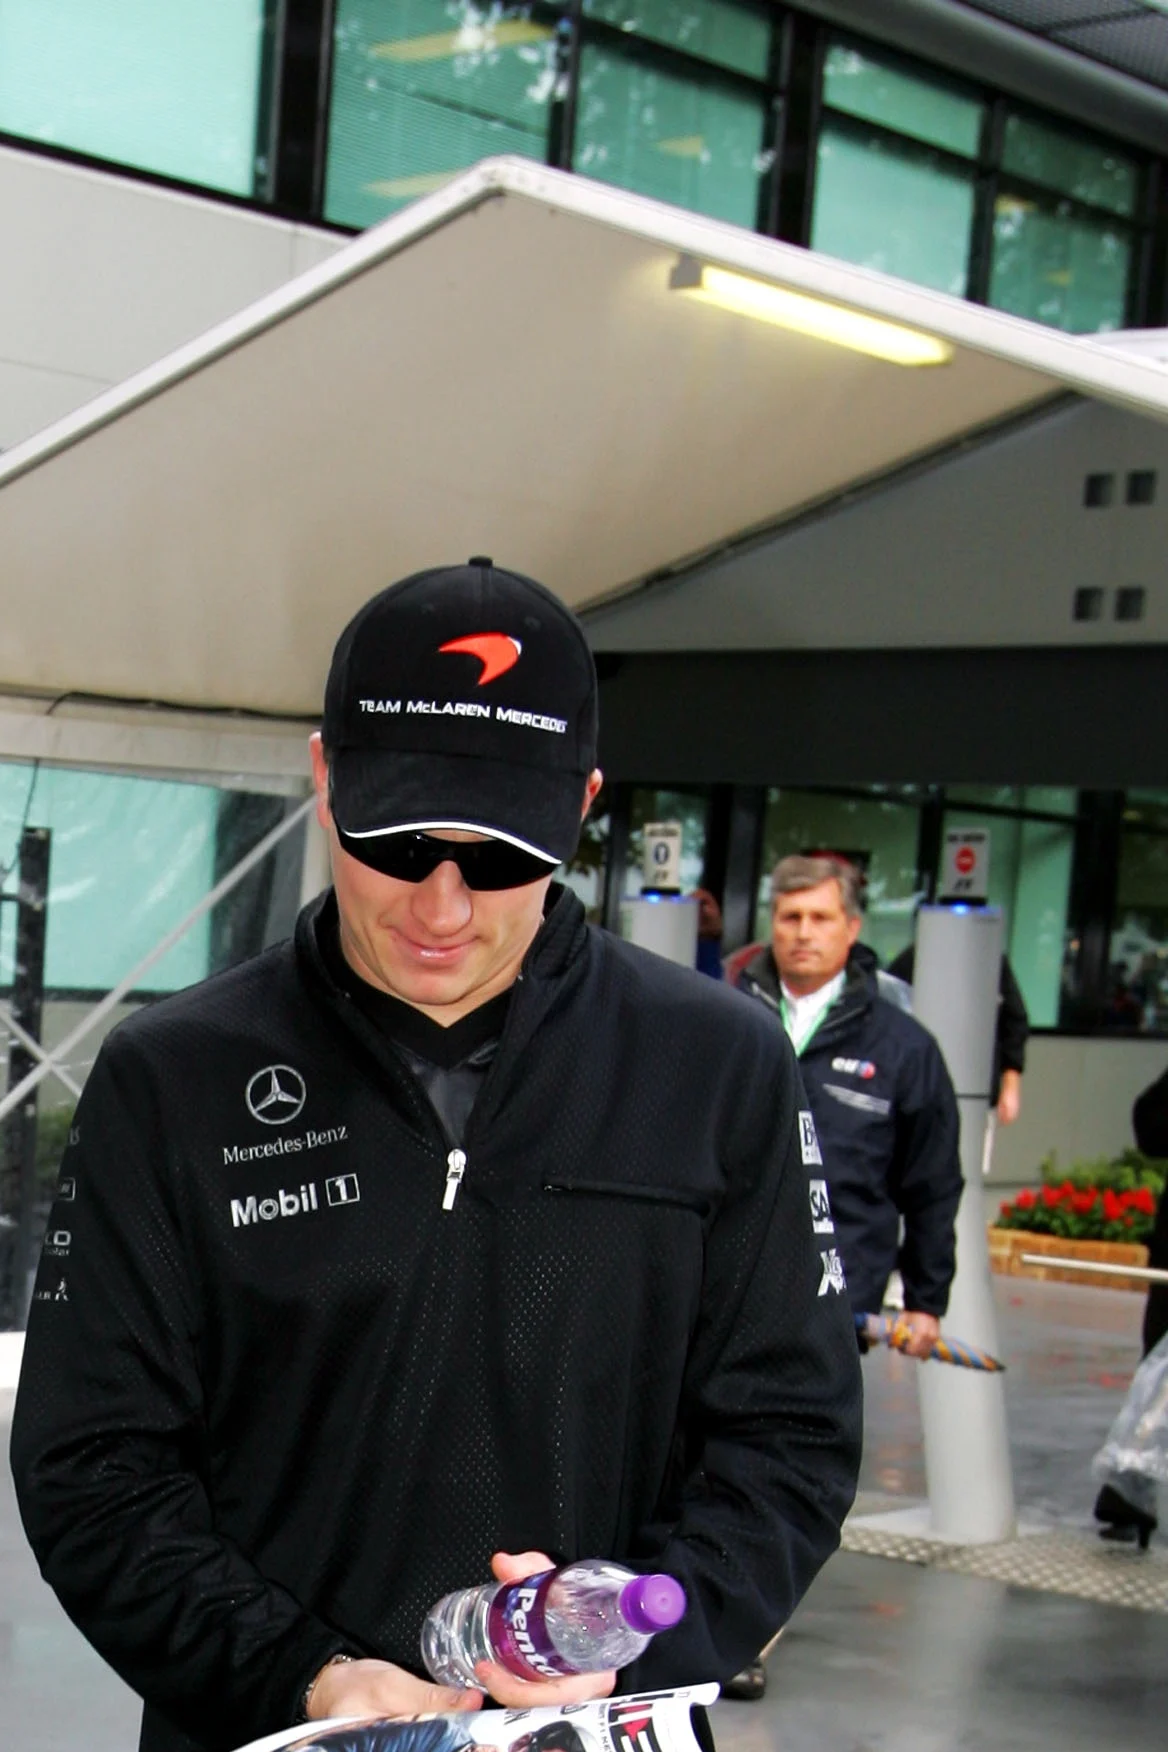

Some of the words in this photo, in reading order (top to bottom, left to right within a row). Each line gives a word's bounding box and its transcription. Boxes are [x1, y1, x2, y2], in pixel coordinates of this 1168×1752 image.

[360, 700, 401, 714] TEAM
[406, 700, 490, 719] McLAREN
[223, 1125, 349, 1166] Mercedes-Benz
[230, 1182, 319, 1228] Mobil
